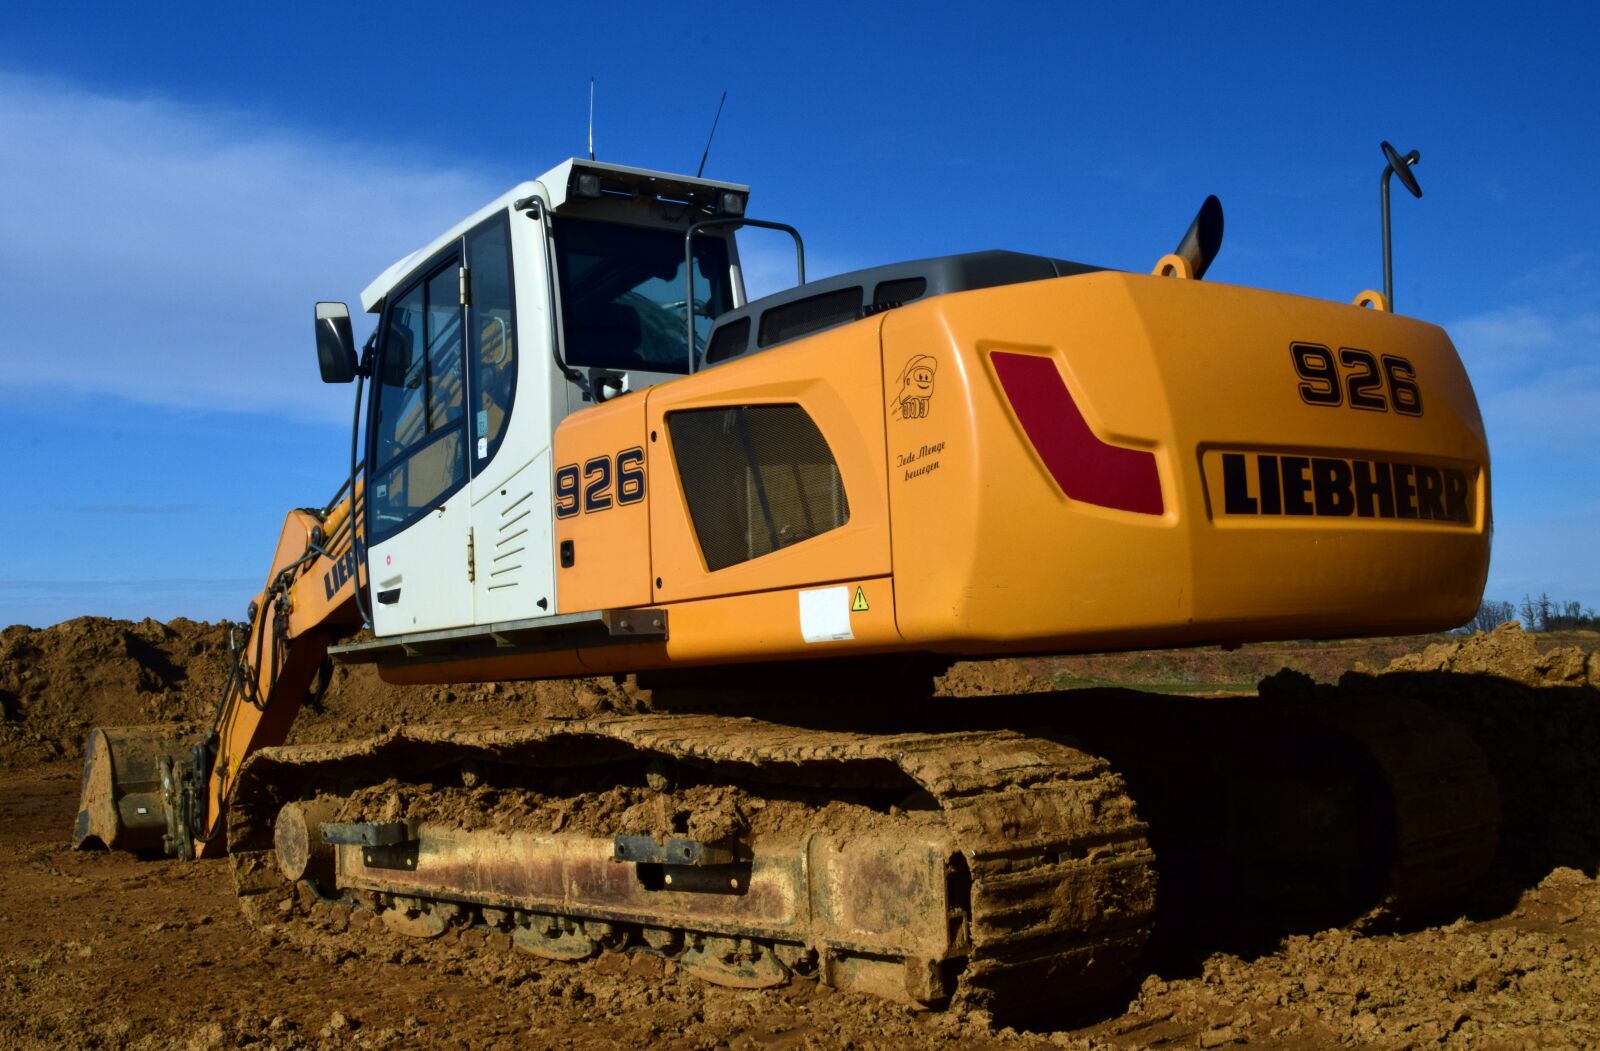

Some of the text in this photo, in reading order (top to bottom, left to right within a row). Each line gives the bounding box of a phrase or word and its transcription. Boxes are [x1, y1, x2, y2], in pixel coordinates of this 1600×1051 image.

[1289, 341, 1423, 417] 926
[555, 446, 646, 520] 926
[904, 461, 940, 482] bewegen
[916, 441, 946, 460] Menge
[1222, 453, 1470, 523] LIEBHERR
